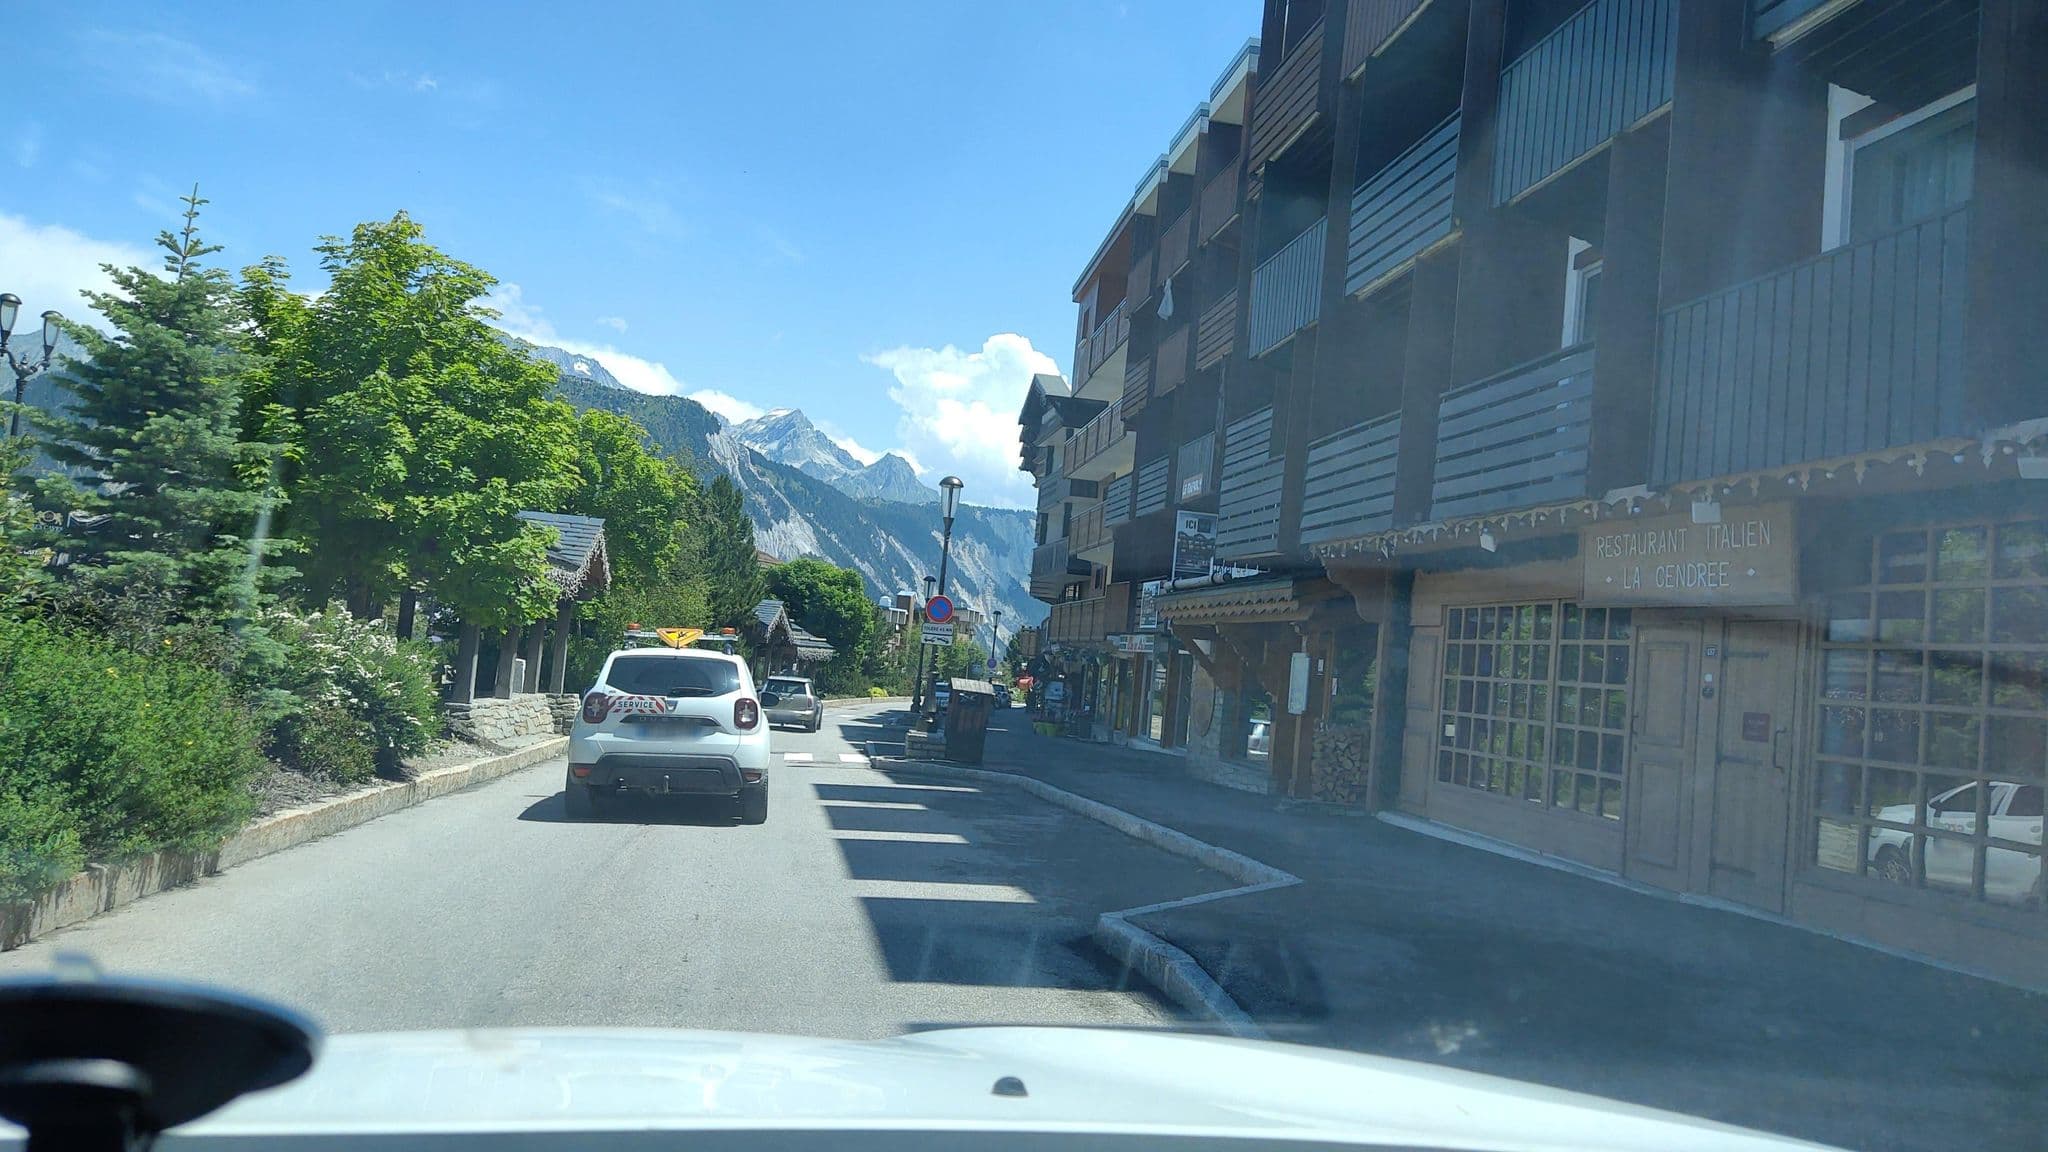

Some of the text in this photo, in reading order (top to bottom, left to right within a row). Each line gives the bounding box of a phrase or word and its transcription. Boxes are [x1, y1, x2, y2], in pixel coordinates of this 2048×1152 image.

[1185, 519, 1197, 530] ICI
[1596, 519, 1771, 559] RESTAURANT ITALIEN
[1623, 566, 1641, 590] LA
[617, 700, 654, 709] SERVICE
